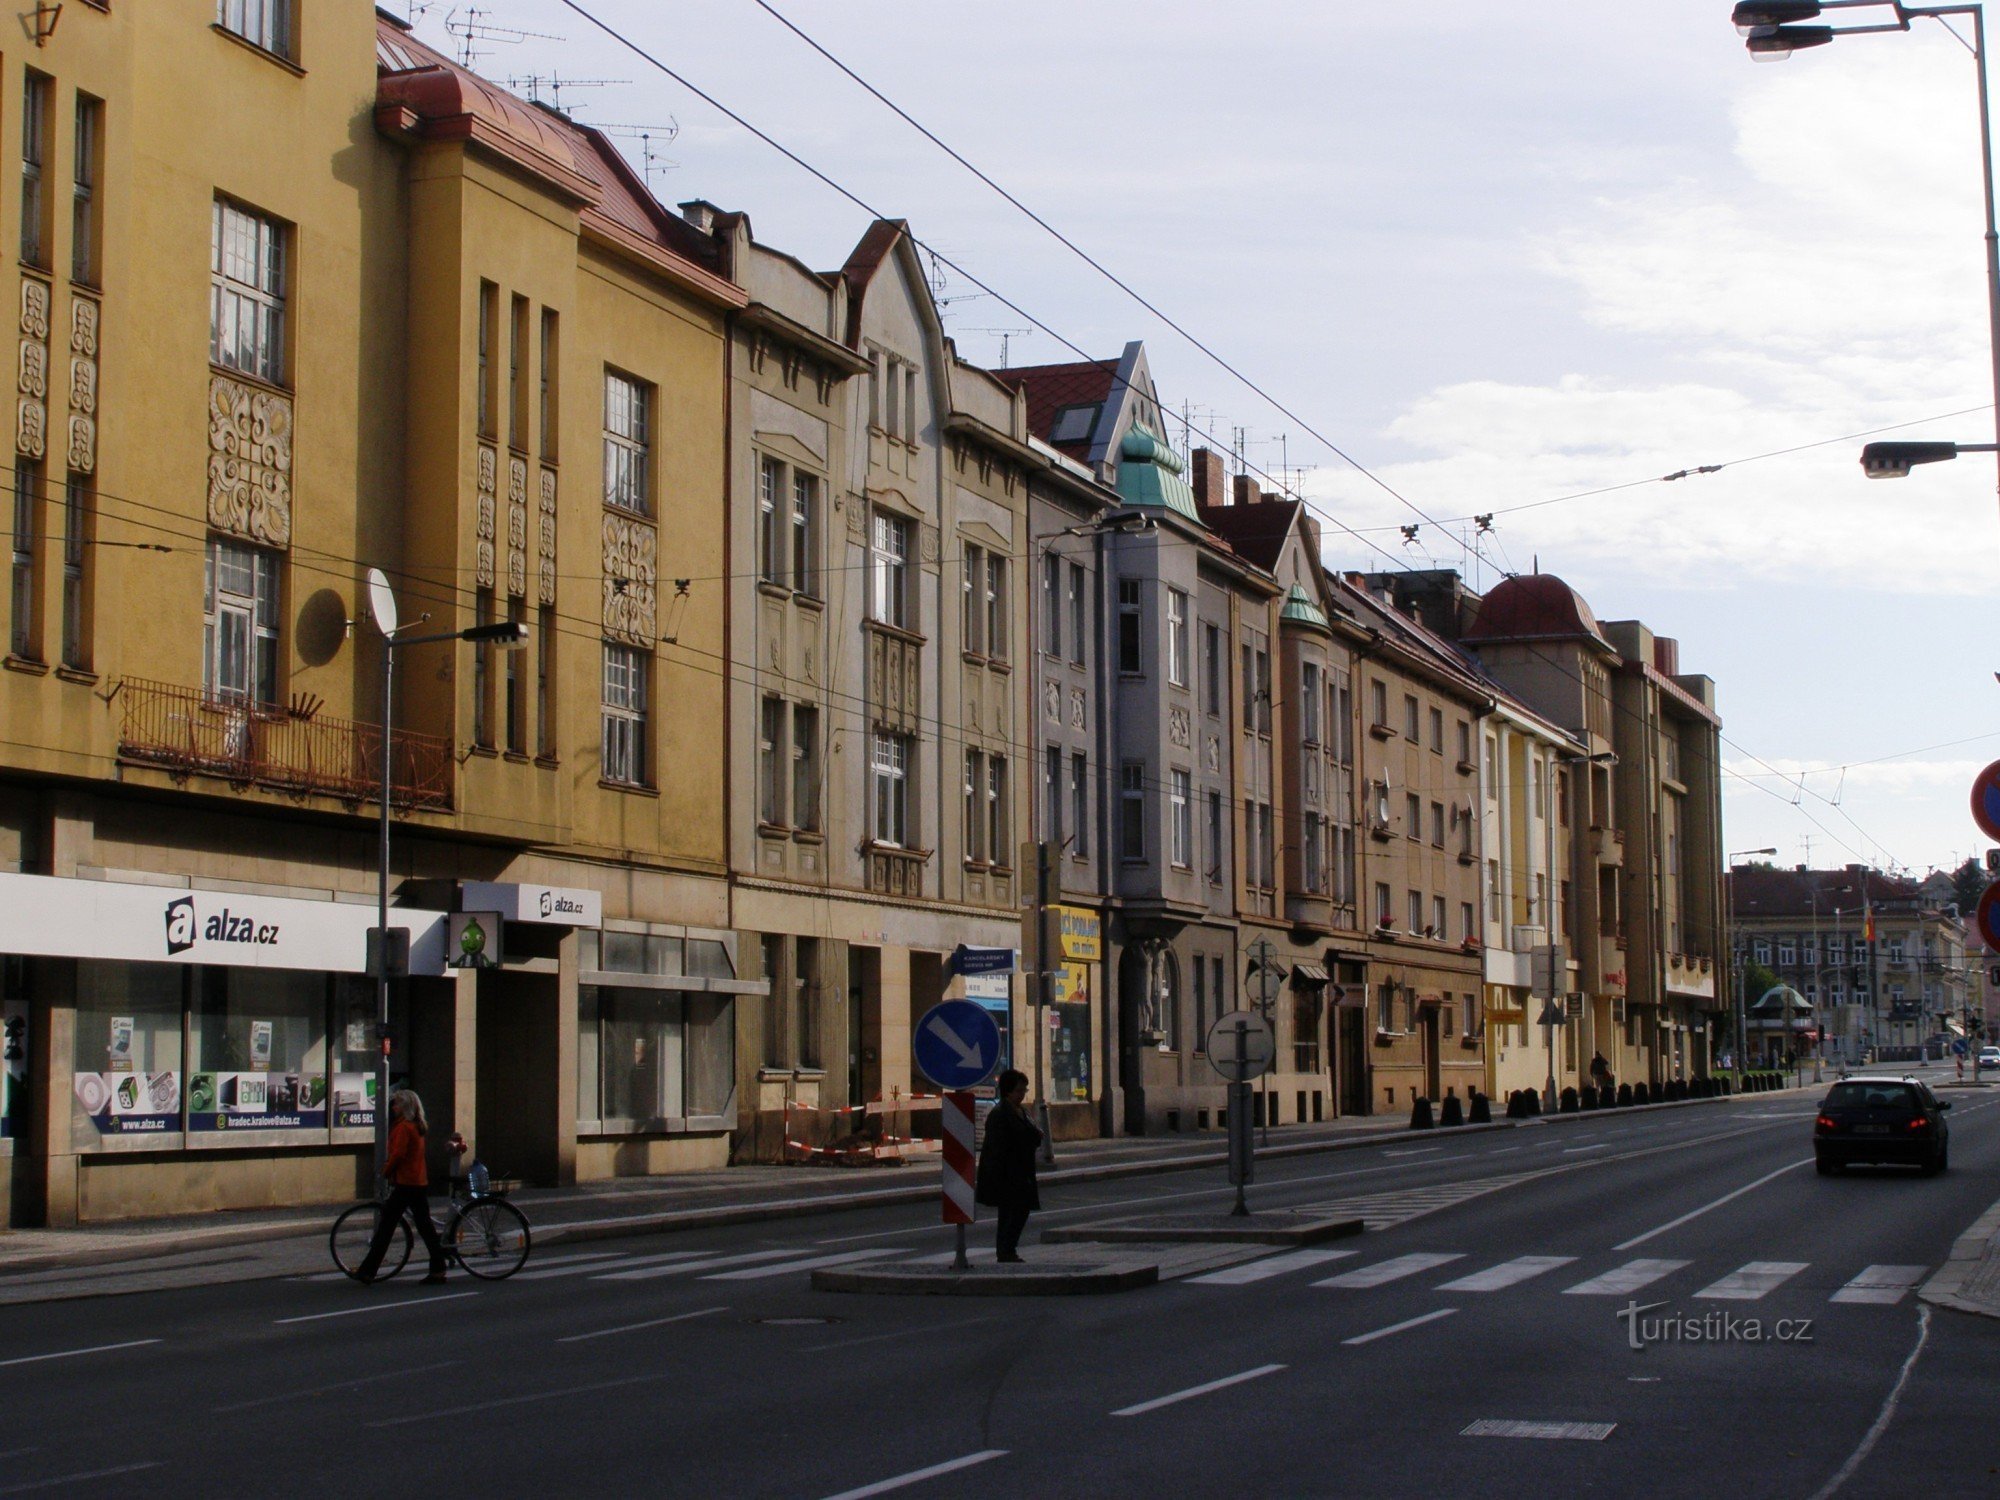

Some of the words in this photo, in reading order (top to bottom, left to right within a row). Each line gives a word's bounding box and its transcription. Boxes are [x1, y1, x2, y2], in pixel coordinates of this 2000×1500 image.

[554, 896, 583, 914] alza.cz
[205, 908, 279, 945] alza.cz
[122, 1118, 166, 1130] www.alza.cz
[228, 1115, 301, 1128] hradec.kralove@alza.cz
[349, 1113, 361, 1124] 495
[362, 1112, 374, 1124] 581
